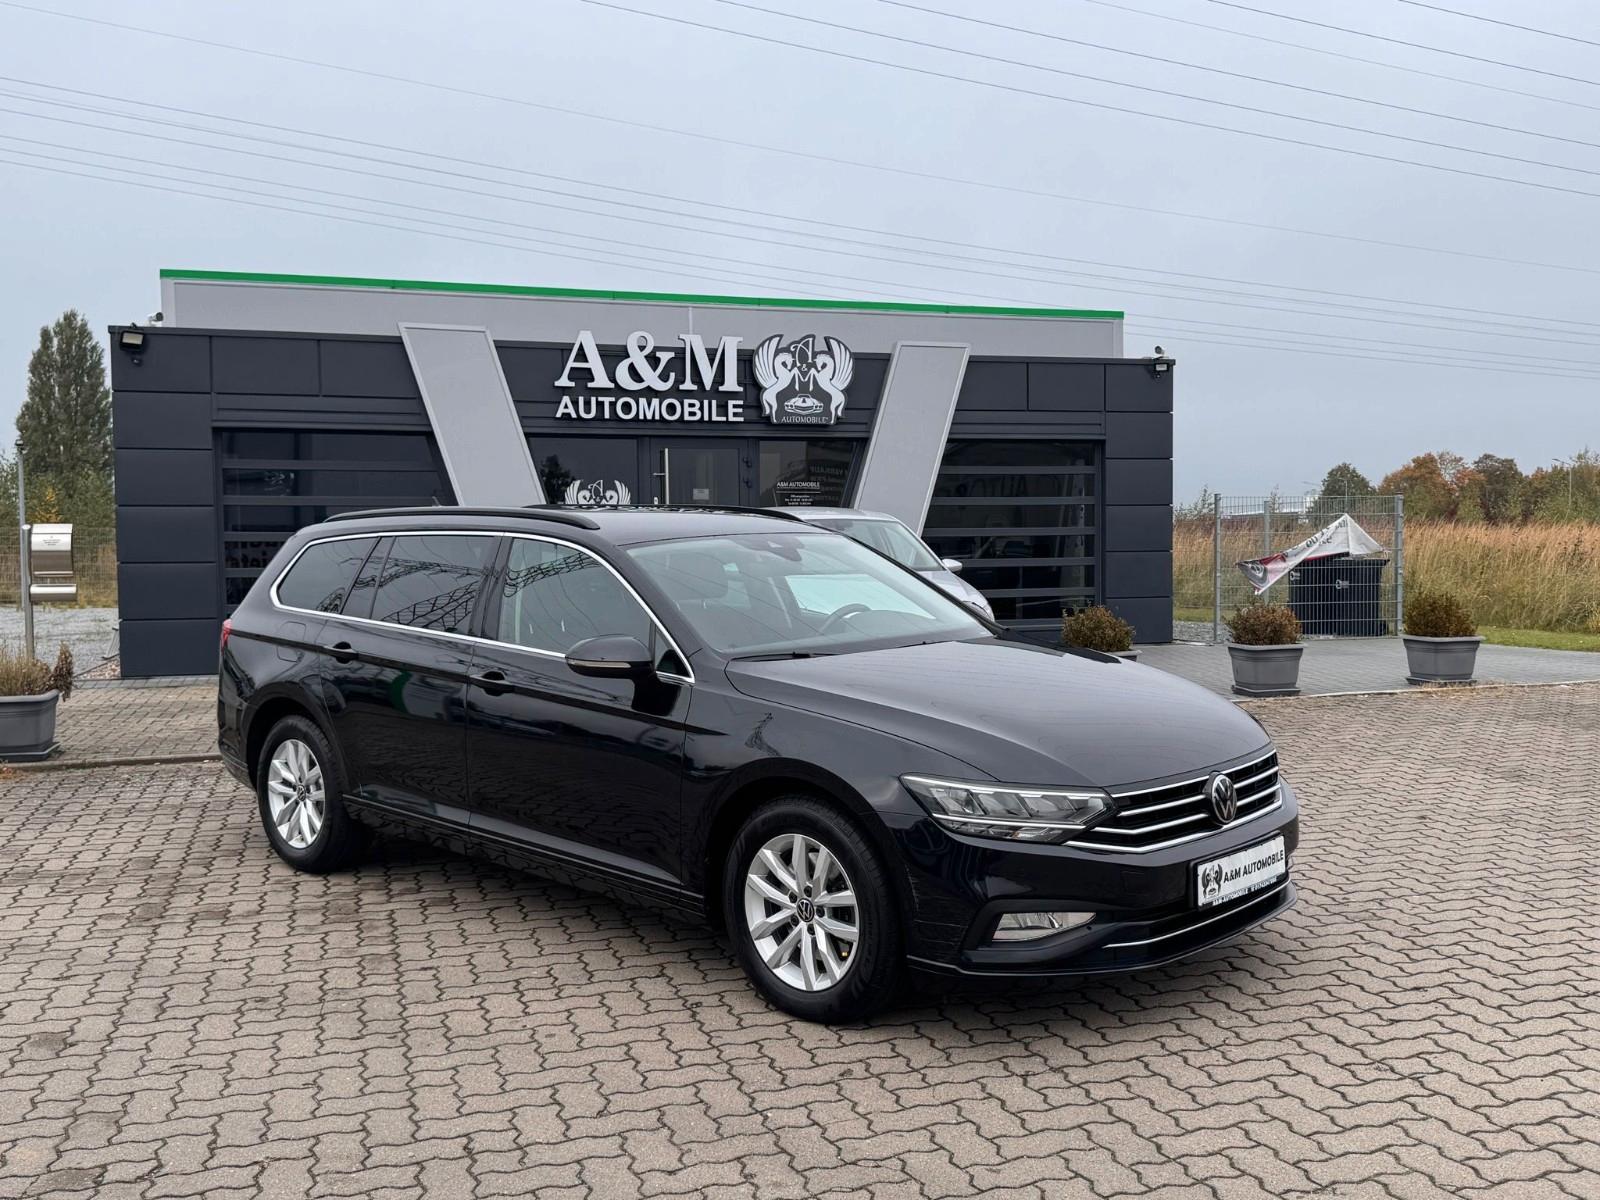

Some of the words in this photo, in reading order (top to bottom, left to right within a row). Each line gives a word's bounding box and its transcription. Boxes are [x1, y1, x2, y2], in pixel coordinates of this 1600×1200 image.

[554, 330, 744, 392] A&M
[555, 395, 745, 421] AUTOMOBILE
[1223, 864, 1242, 884] A&M
[1243, 850, 1284, 876] AUTOMOBILE
